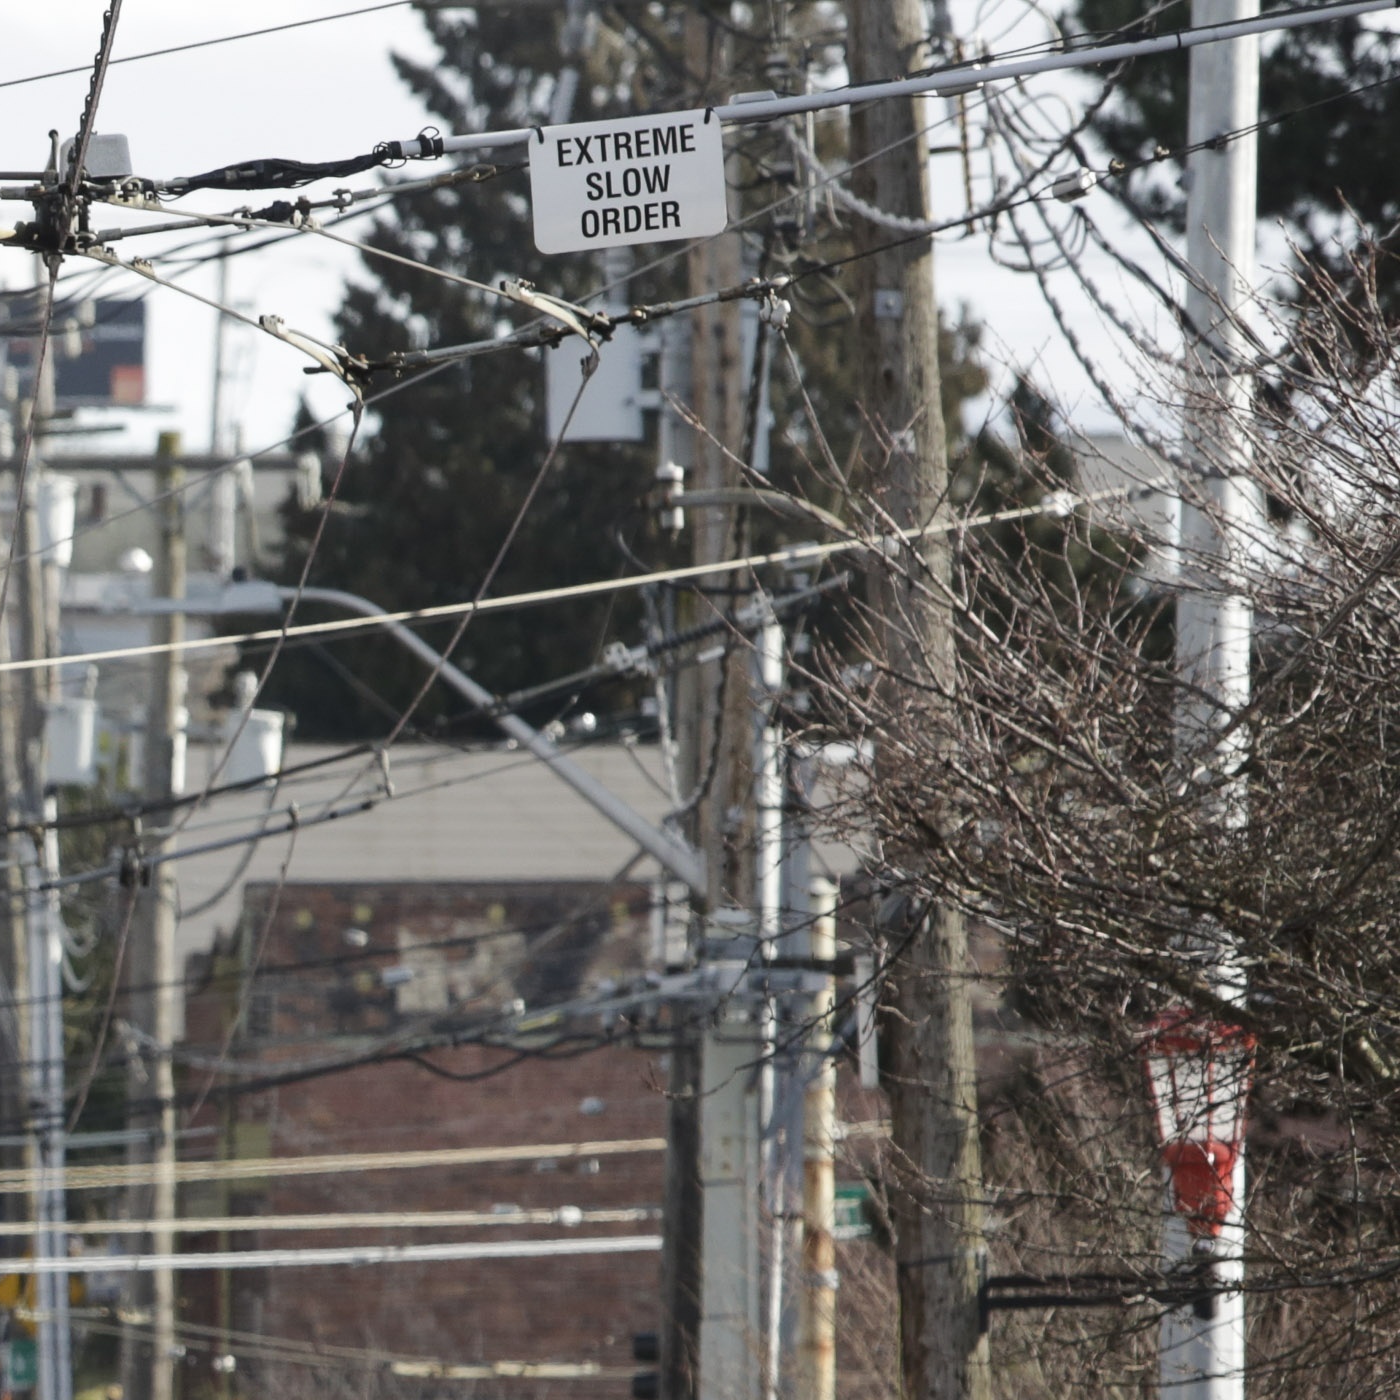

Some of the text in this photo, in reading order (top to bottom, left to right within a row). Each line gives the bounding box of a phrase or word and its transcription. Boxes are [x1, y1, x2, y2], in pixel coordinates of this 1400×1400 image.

[557, 124, 696, 167] EXTREME
[586, 164, 670, 201] SLOW
[581, 201, 681, 238] ORDER
